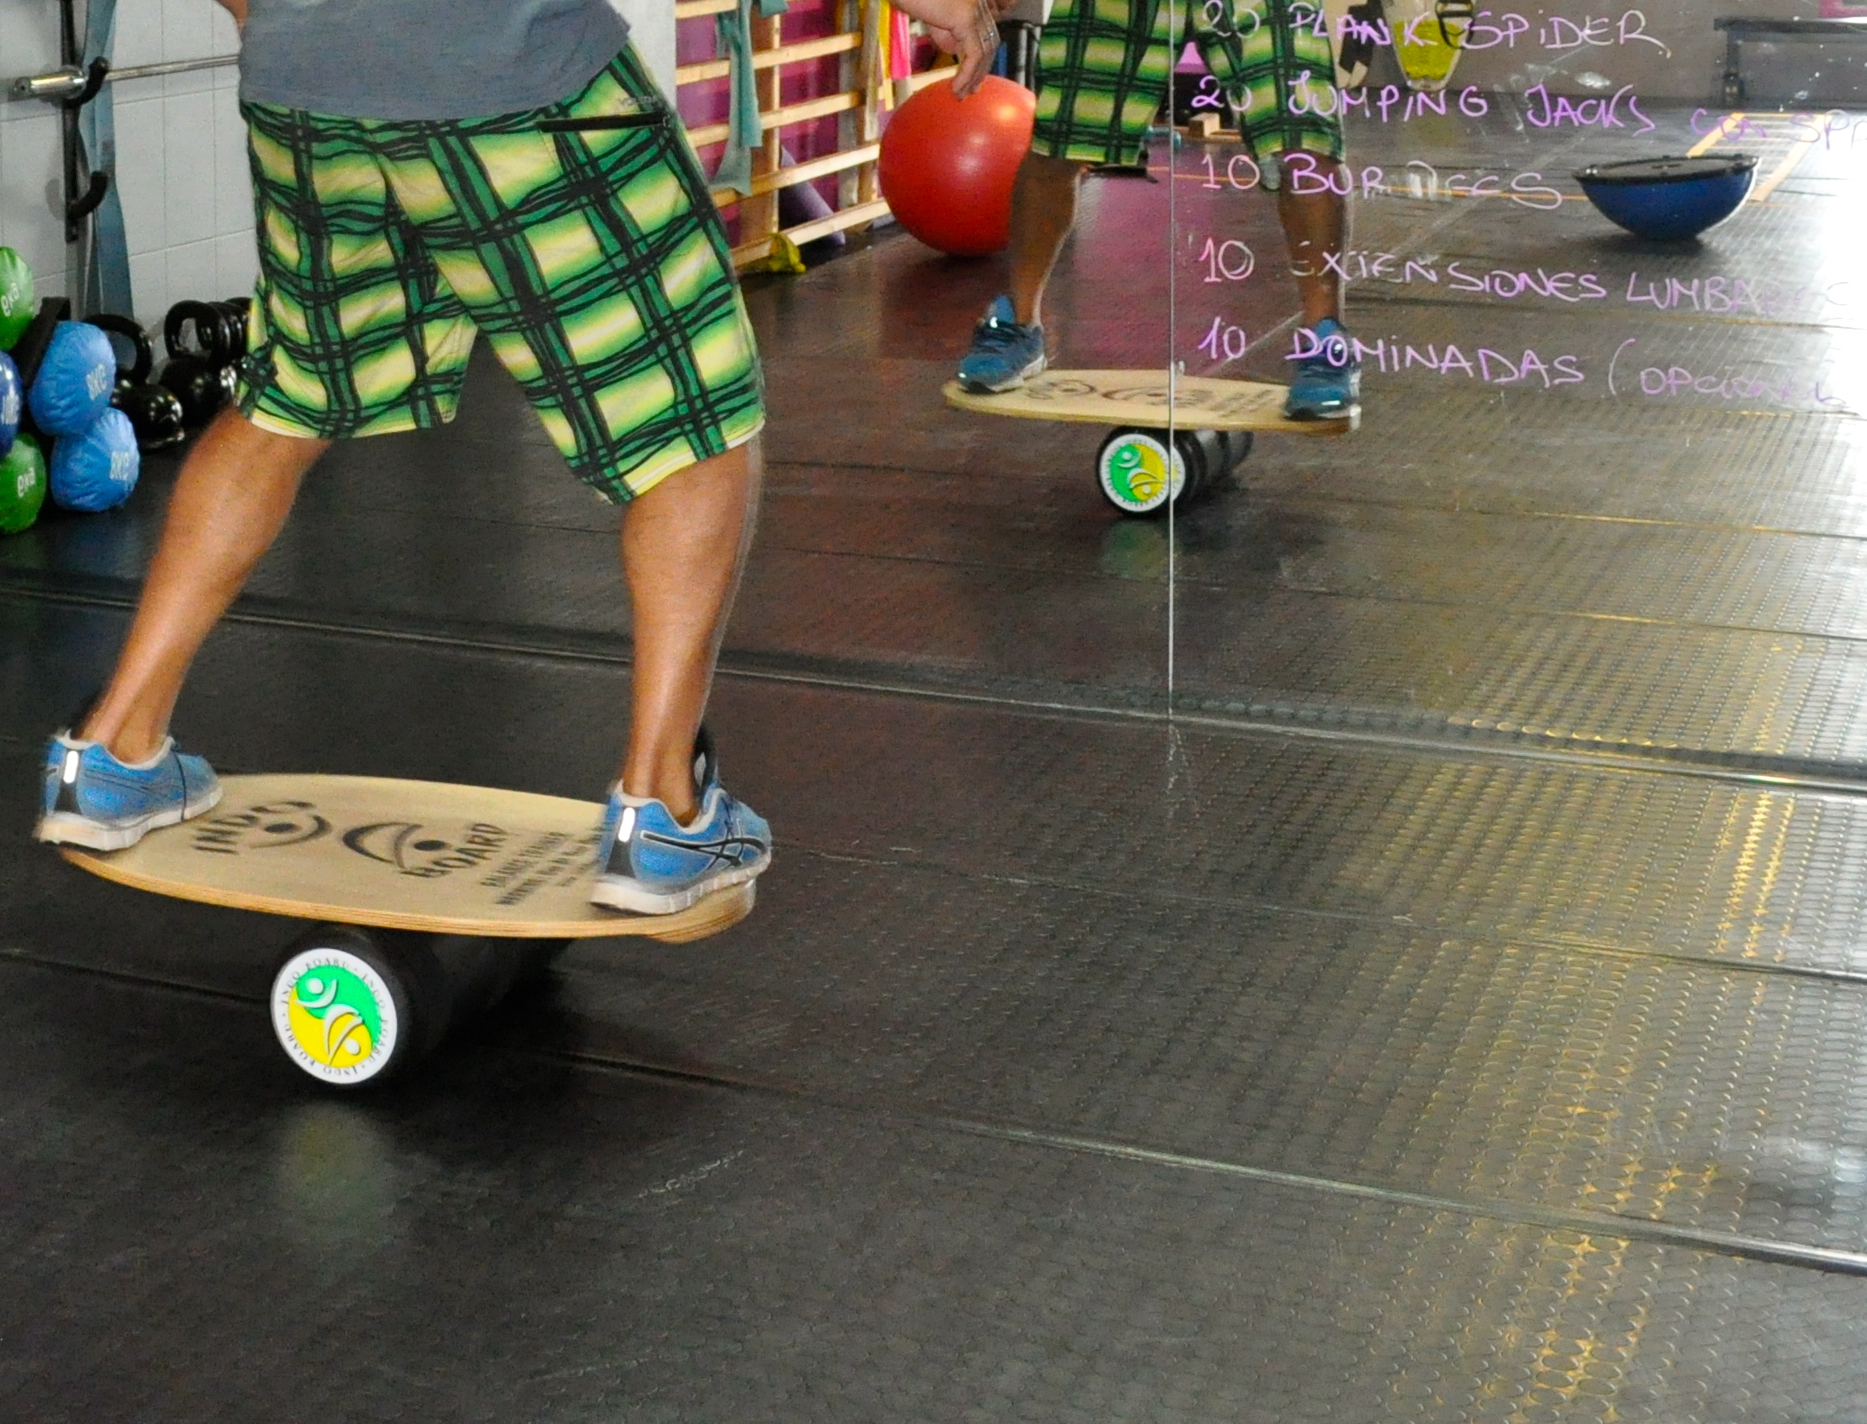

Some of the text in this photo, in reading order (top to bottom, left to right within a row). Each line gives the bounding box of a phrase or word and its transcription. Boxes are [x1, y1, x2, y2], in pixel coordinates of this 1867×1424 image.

[1191, 75, 1252, 112] 20
[1201, 153, 1260, 190] 10
[1199, 237, 1255, 283] 10
[1198, 316, 1246, 360] 10
[399, 822, 506, 877] BOARD
